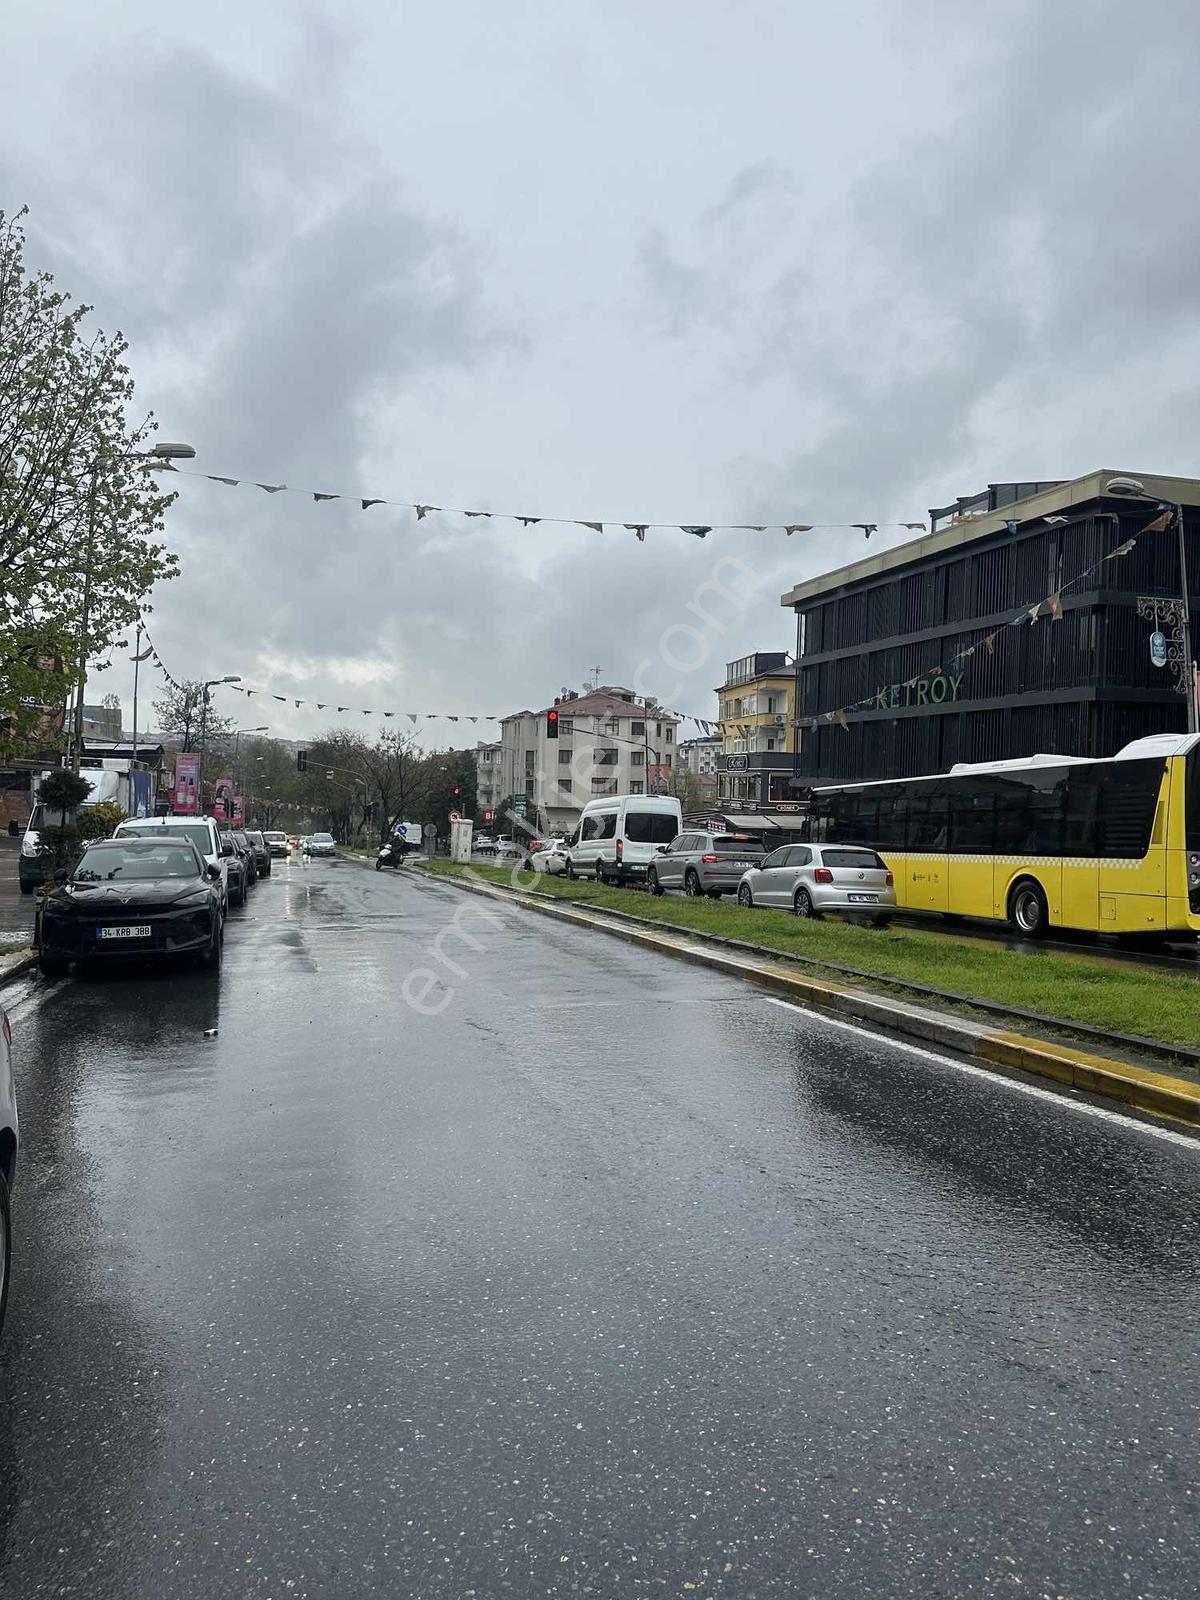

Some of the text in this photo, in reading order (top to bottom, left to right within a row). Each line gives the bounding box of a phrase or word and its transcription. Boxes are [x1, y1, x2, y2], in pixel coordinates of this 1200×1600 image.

[876, 671, 964, 711] KETROY
[103, 927, 150, 937] 34 KRB 388
